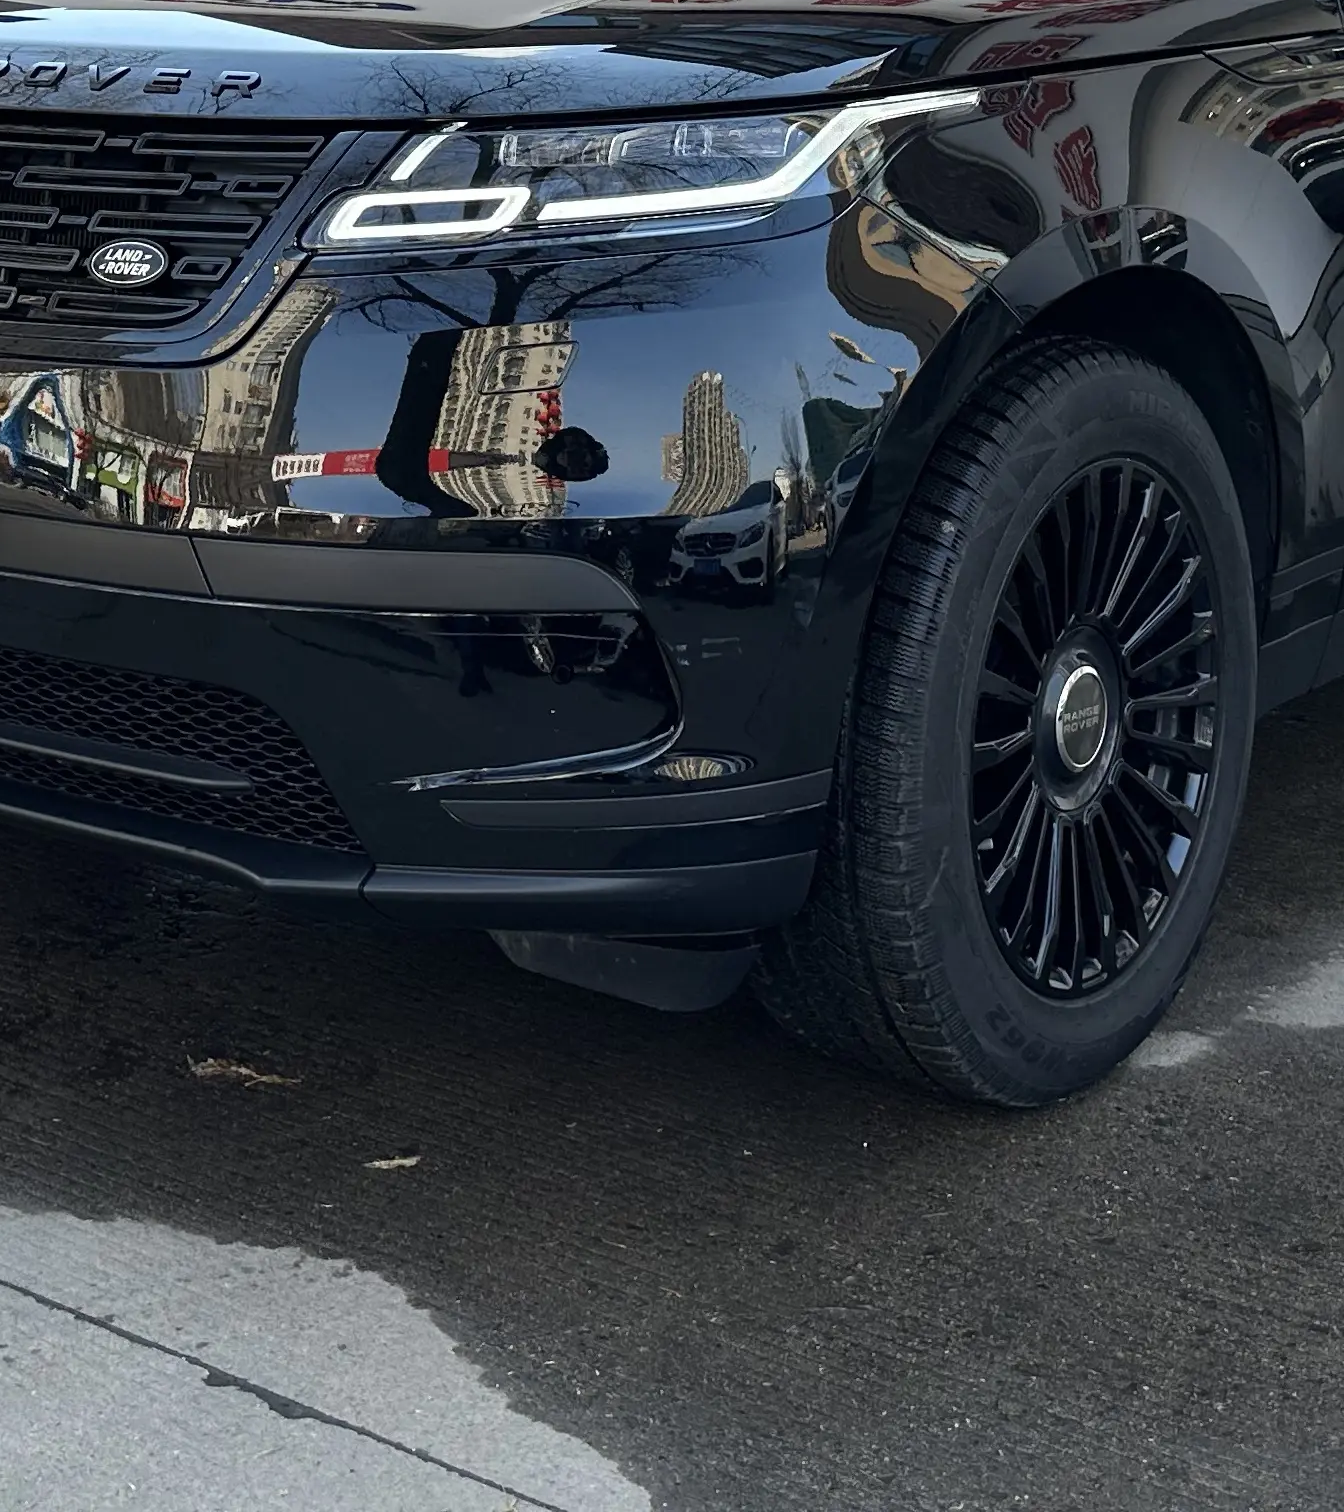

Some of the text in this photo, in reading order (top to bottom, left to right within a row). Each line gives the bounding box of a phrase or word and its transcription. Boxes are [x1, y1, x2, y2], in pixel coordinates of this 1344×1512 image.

[104, 248, 144, 262] LAND
[104, 261, 151, 277] ROVER
[1063, 704, 1100, 722] RANGE
[1063, 715, 1100, 734] ROVER
